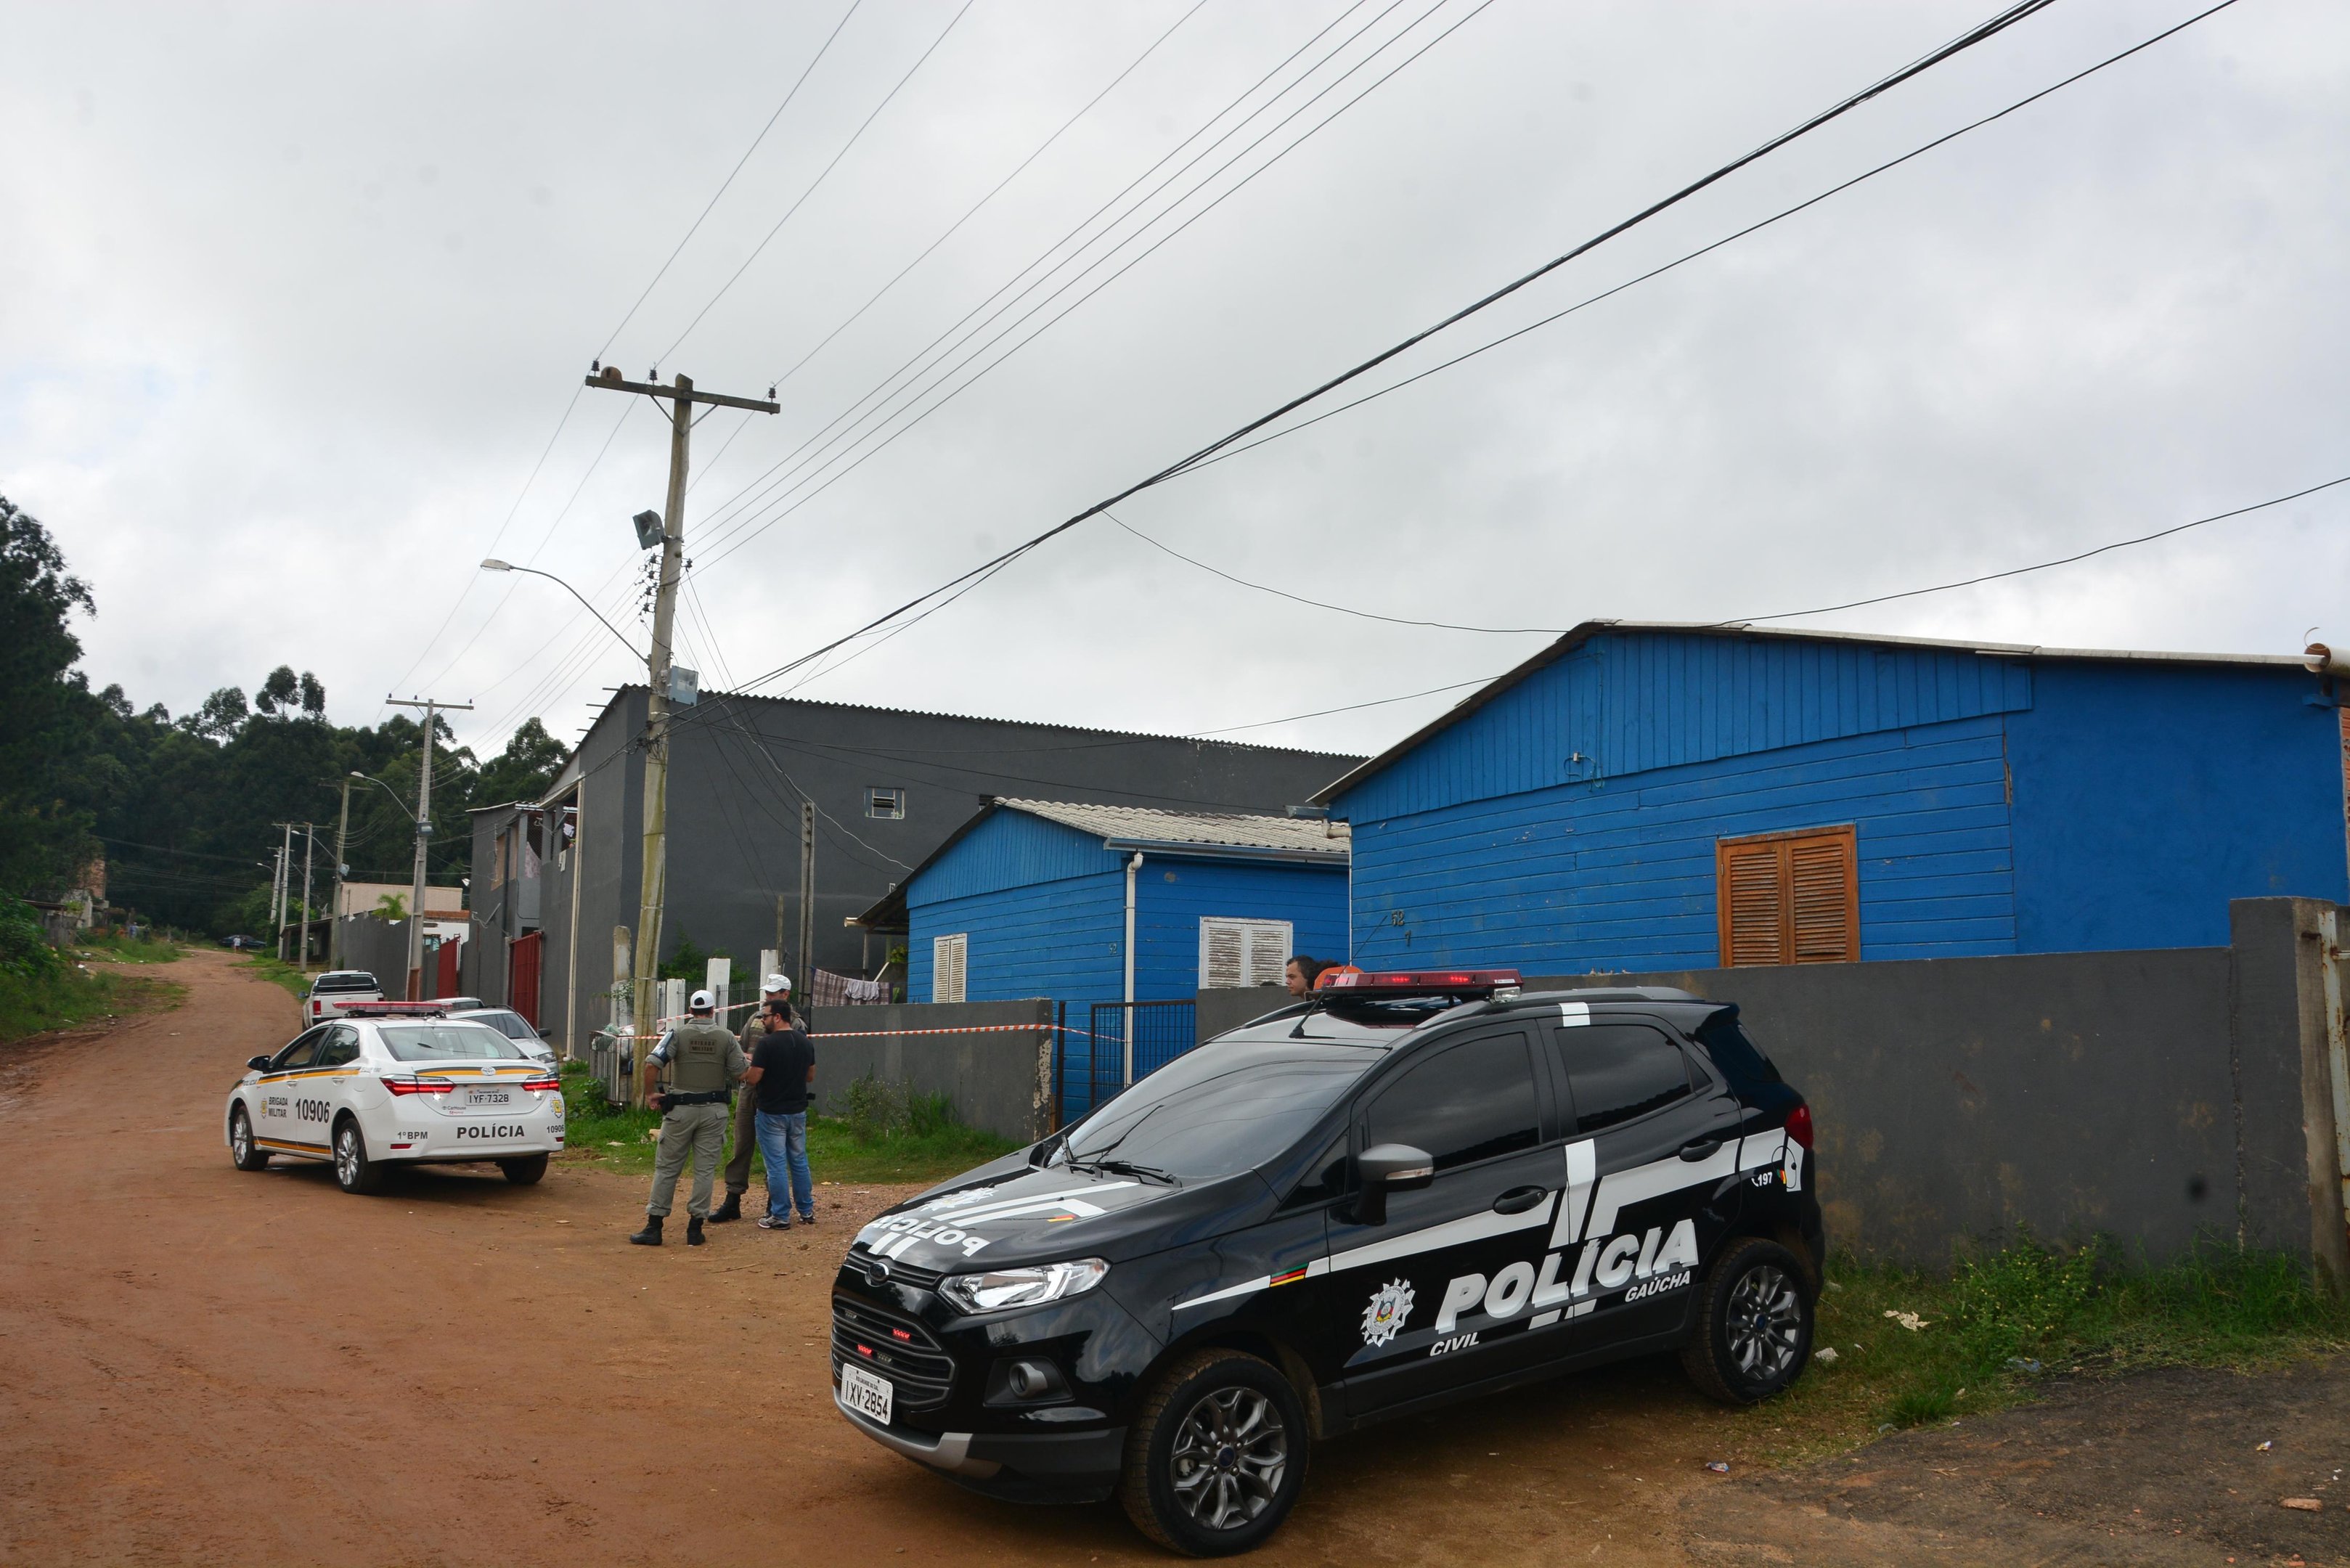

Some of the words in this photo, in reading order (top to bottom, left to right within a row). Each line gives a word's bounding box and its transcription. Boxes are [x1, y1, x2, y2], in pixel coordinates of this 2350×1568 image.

[269, 1097, 288, 1106] BRIGADA
[469, 1094, 509, 1103] IYF-7328
[269, 1108, 287, 1118] MILITAR
[296, 1098, 330, 1123] 10906
[457, 1123, 525, 1139] POLÍCIA
[547, 1124, 564, 1134] 10906
[1758, 1171, 1773, 1186] 197
[1435, 1219, 1699, 1334] POLÍCIA
[1625, 1270, 1690, 1302] GAÚCHA
[1429, 1332, 1480, 1357] CIVIL
